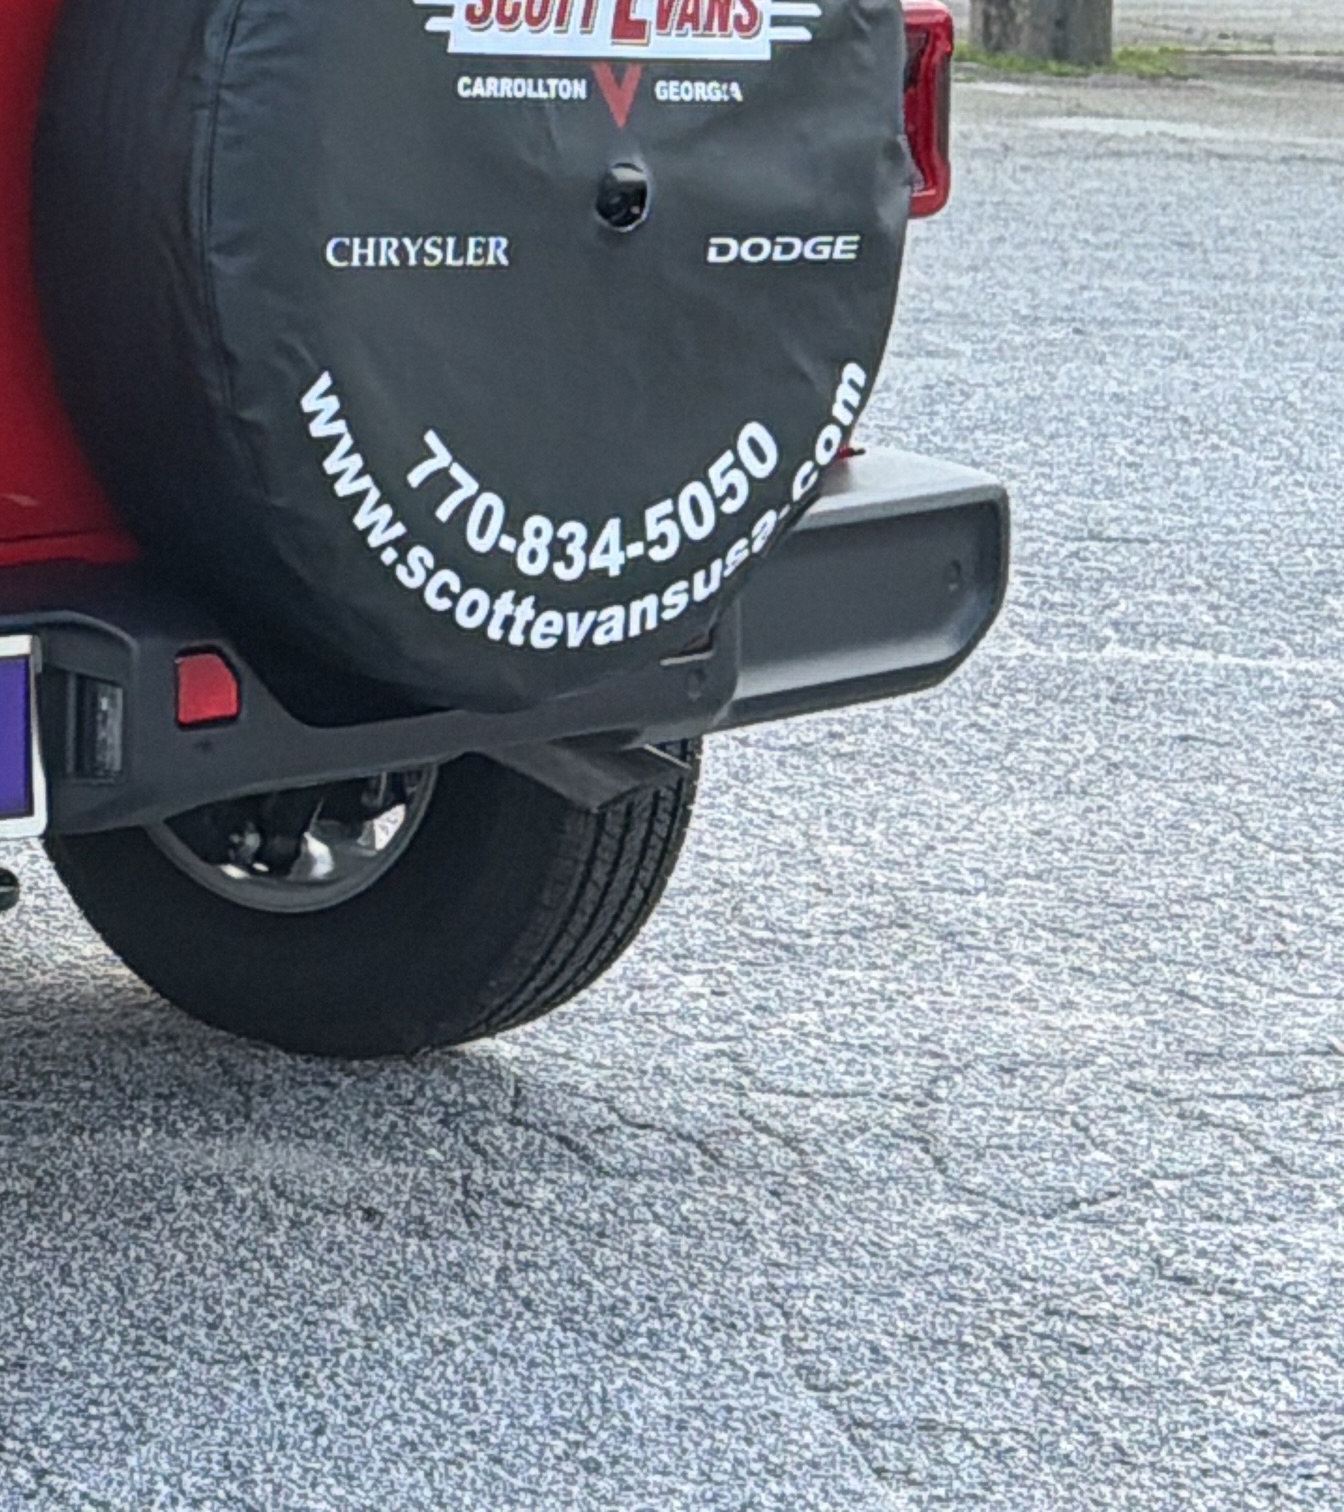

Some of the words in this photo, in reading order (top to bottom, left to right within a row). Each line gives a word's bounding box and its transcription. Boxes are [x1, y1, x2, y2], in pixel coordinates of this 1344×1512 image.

[457, 76, 587, 101] CARROLLTON
[655, 78, 743, 103] GEORGIA
[325, 235, 511, 269] CHRYSLER
[707, 235, 861, 263] DODGE
[300, 360, 867, 650] www.scottevansusa.com
[405, 419, 781, 583] 770-834-5050
